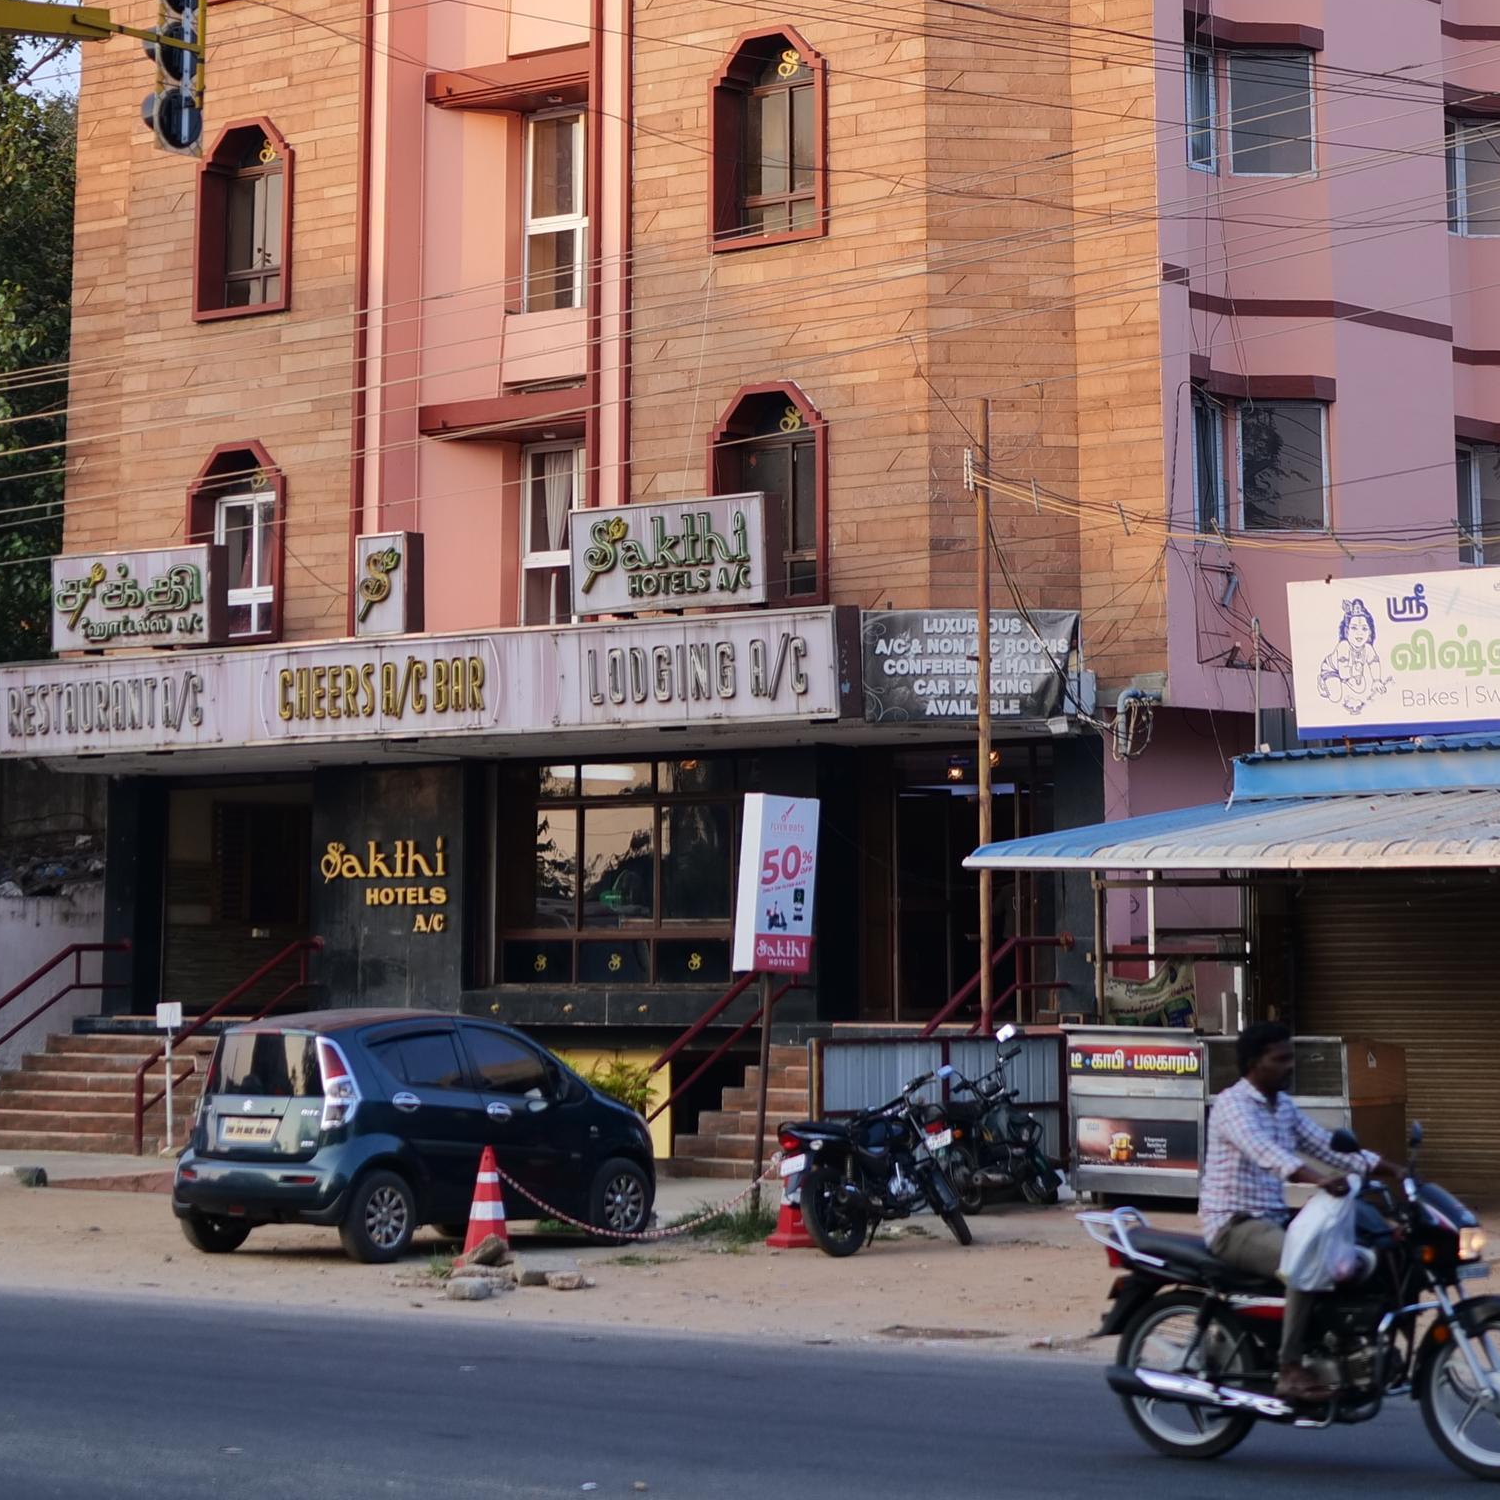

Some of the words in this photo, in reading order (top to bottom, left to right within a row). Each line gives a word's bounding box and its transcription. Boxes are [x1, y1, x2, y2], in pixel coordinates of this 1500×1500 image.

[582, 509, 752, 577] Sakthi
[54, 562, 203, 620] சக்தி
[627, 568, 711, 598] HOTELS
[716, 562, 752, 593] A/C
[1385, 582, 1429, 622] ஸ்ரீ
[923, 617, 1022, 635] LUXUROUS
[875, 638, 908, 656] A/C
[910, 639, 923, 654] &
[927, 638, 965, 655] NON
[969, 638, 1002, 654] AC
[587, 639, 737, 706] LODGING
[749, 631, 810, 702] A/C
[884, 659, 1001, 676] CONFERENE
[277, 661, 377, 722] CHEERS
[380, 654, 428, 721] A/C
[432, 655, 486, 714] BAR
[913, 679, 950, 696] CAR
[954, 679, 1033, 696] PAKING
[1401, 684, 1460, 709] Bakes
[6, 676, 158, 738] RESTAURANT
[161, 669, 205, 732] A/C
[320, 835, 447, 884] Sakthi
[365, 886, 448, 906] HOTELS
[412, 913, 445, 933] A/C
[756, 938, 807, 958] Sakthi
[768, 958, 796, 967] HOTELS
[1090, 1048, 1125, 1071] காபி
[1133, 1050, 1198, 1075] பலகாரம்
